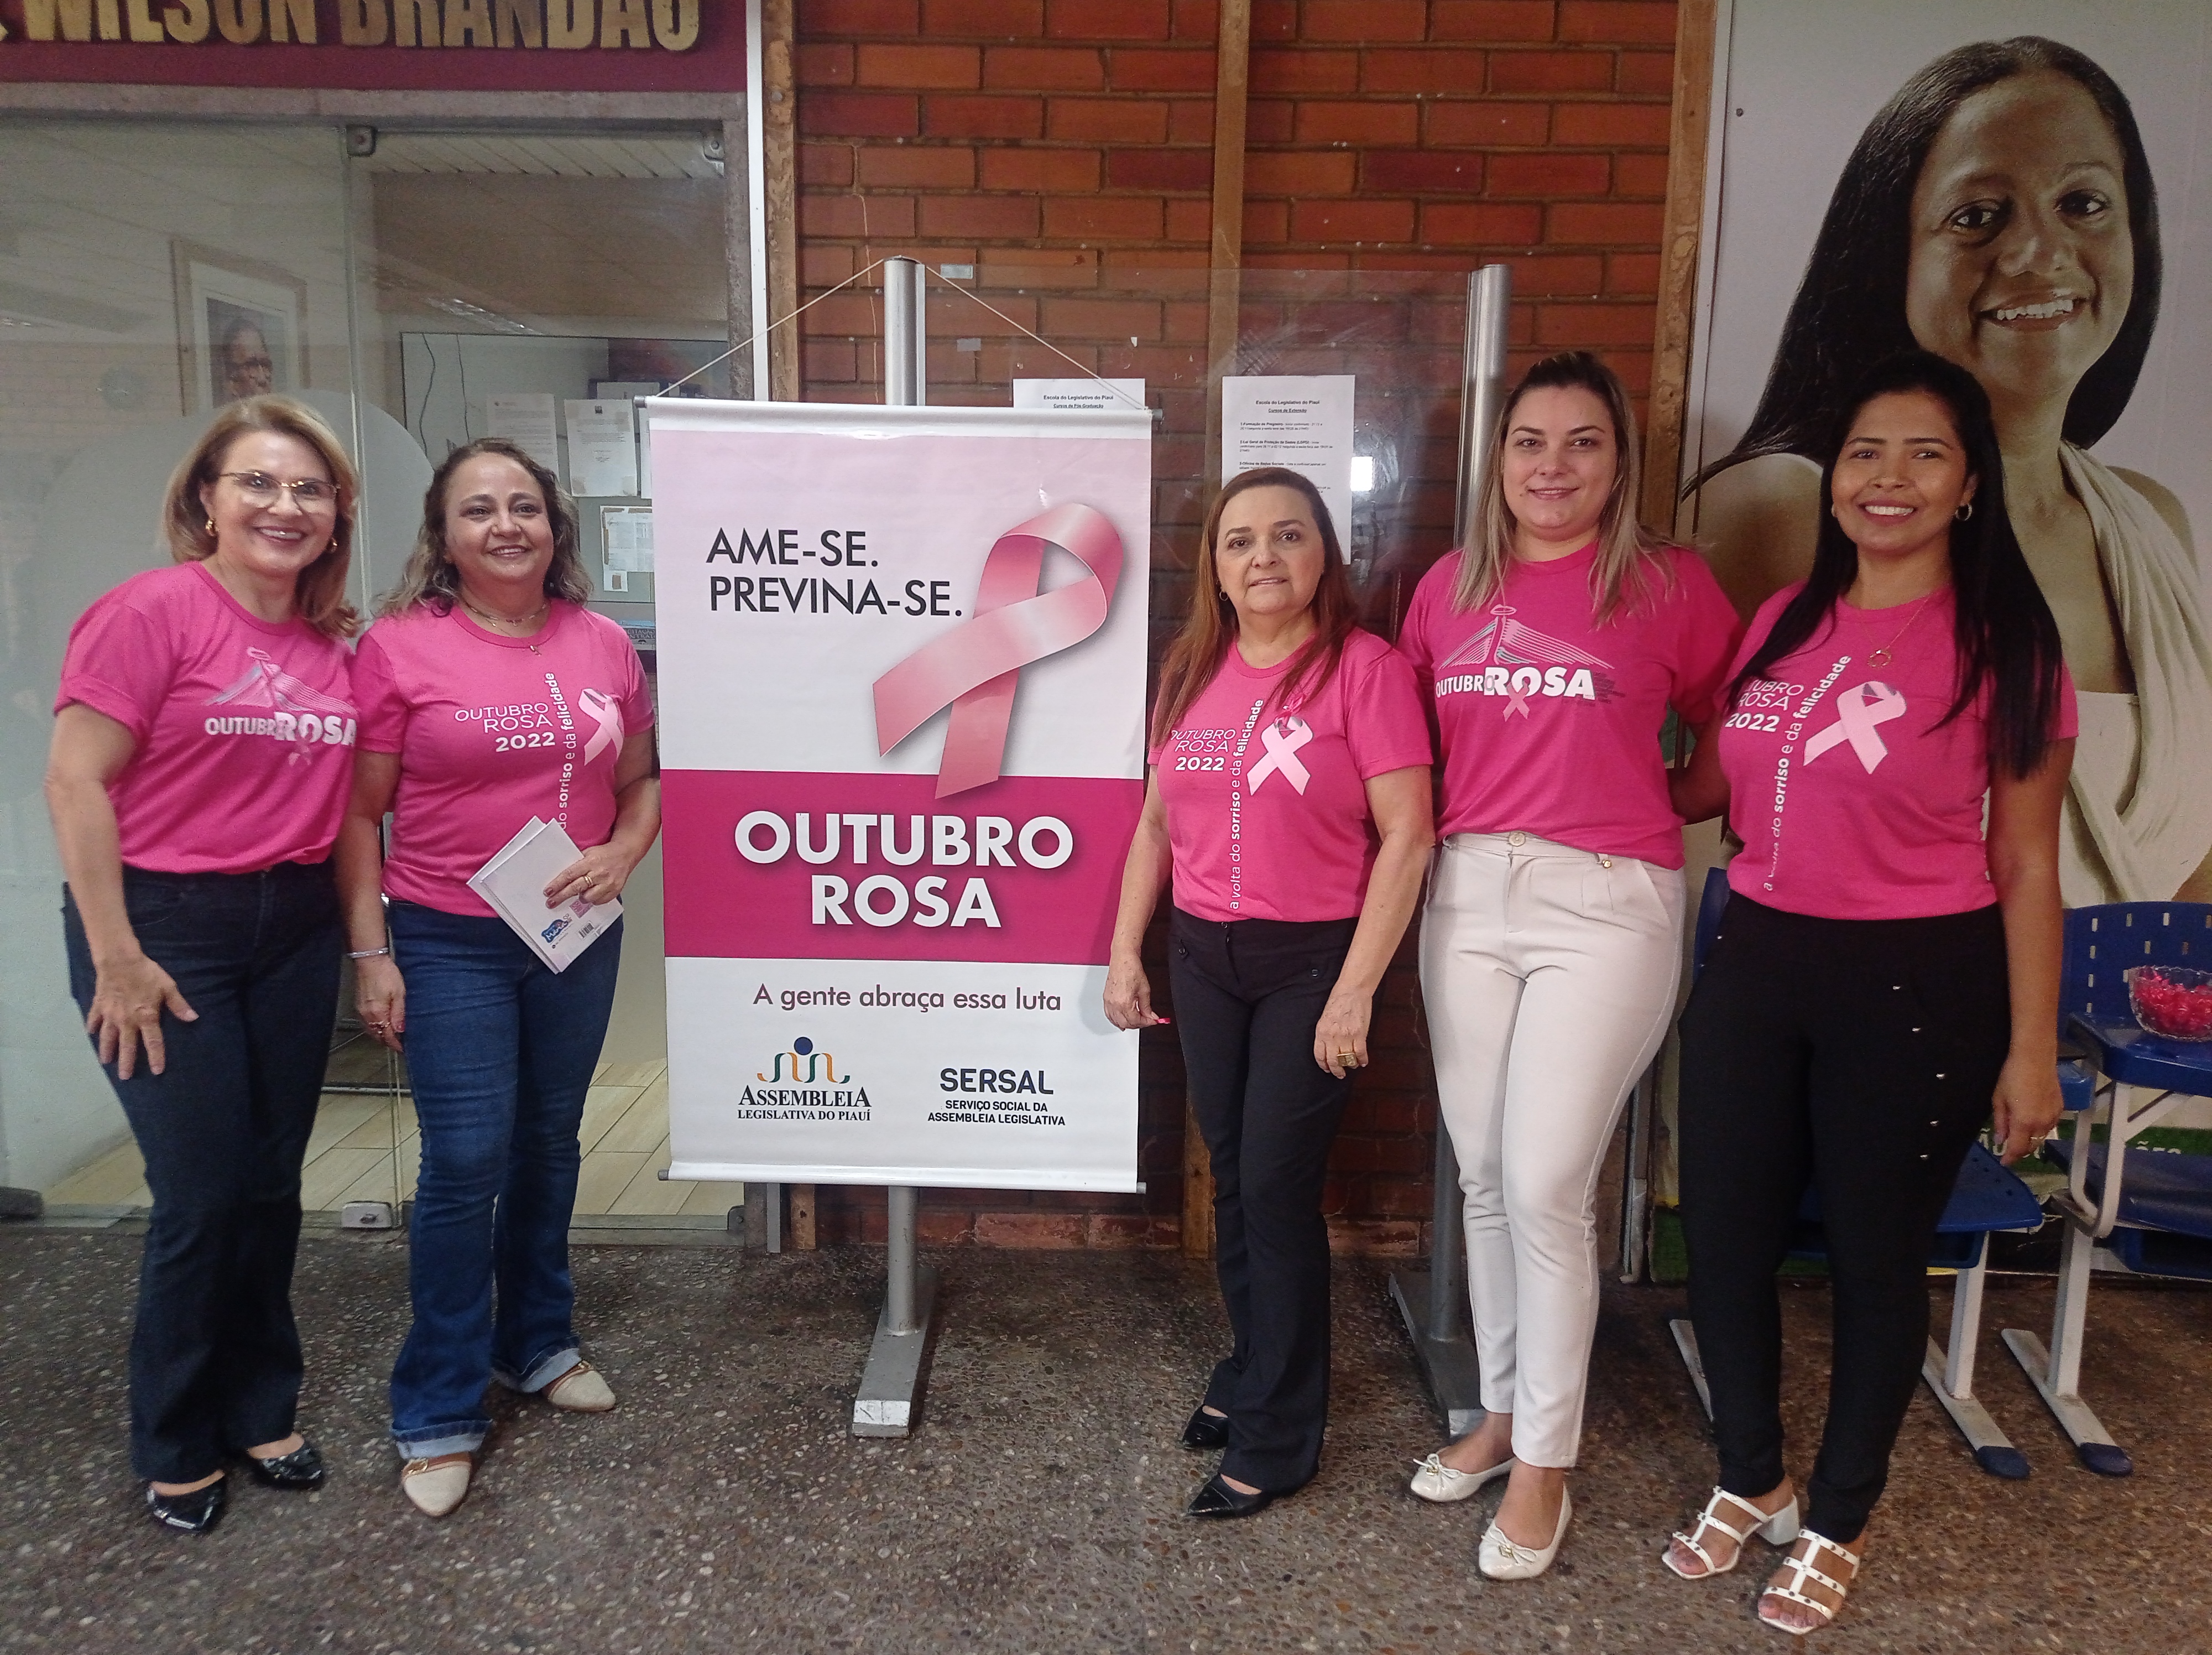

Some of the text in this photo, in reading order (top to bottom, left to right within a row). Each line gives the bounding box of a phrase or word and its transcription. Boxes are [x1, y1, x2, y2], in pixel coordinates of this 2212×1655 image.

[706, 527, 878, 567] AME-SE.
[711, 576, 962, 617] PREVINA-SE.
[1483, 666, 1596, 701] ROSA
[1792, 655, 1852, 719] felicidade
[455, 702, 549, 721] OUTUBRO
[545, 673, 575, 731] felicidade
[483, 714, 553, 733] ROSA
[1724, 712, 1780, 732] 2022
[1785, 722, 1803, 741] da
[495, 731, 556, 752] 2022
[563, 733, 576, 748] da
[1171, 729, 1236, 741] OUTUBRO
[1175, 740, 1228, 752] ROSA
[1781, 745, 1793, 754] e
[1175, 757, 1224, 771] 2022
[559, 763, 573, 808] sorriso
[1774, 758, 1790, 813] sorriso
[1229, 699, 1264, 909] a volta do sorriso e da felicidade
[1771, 818, 1781, 837] do
[735, 811, 1073, 869] OUTUBRO
[811, 875, 1001, 928] ROSA
[753, 983, 1062, 1013] A gente abraça essa luta
[940, 1068, 1054, 1095] SERSAL
[738, 1085, 872, 1108] ASSEMBLEIA
[945, 1100, 1047, 1113] SERVIÇO SOCIAL DA
[738, 1109, 871, 1121] LEGISLATIVA DO PIAUÍ
[928, 1112, 1066, 1126] ASSEMBLEIA LEGISLATIVA
